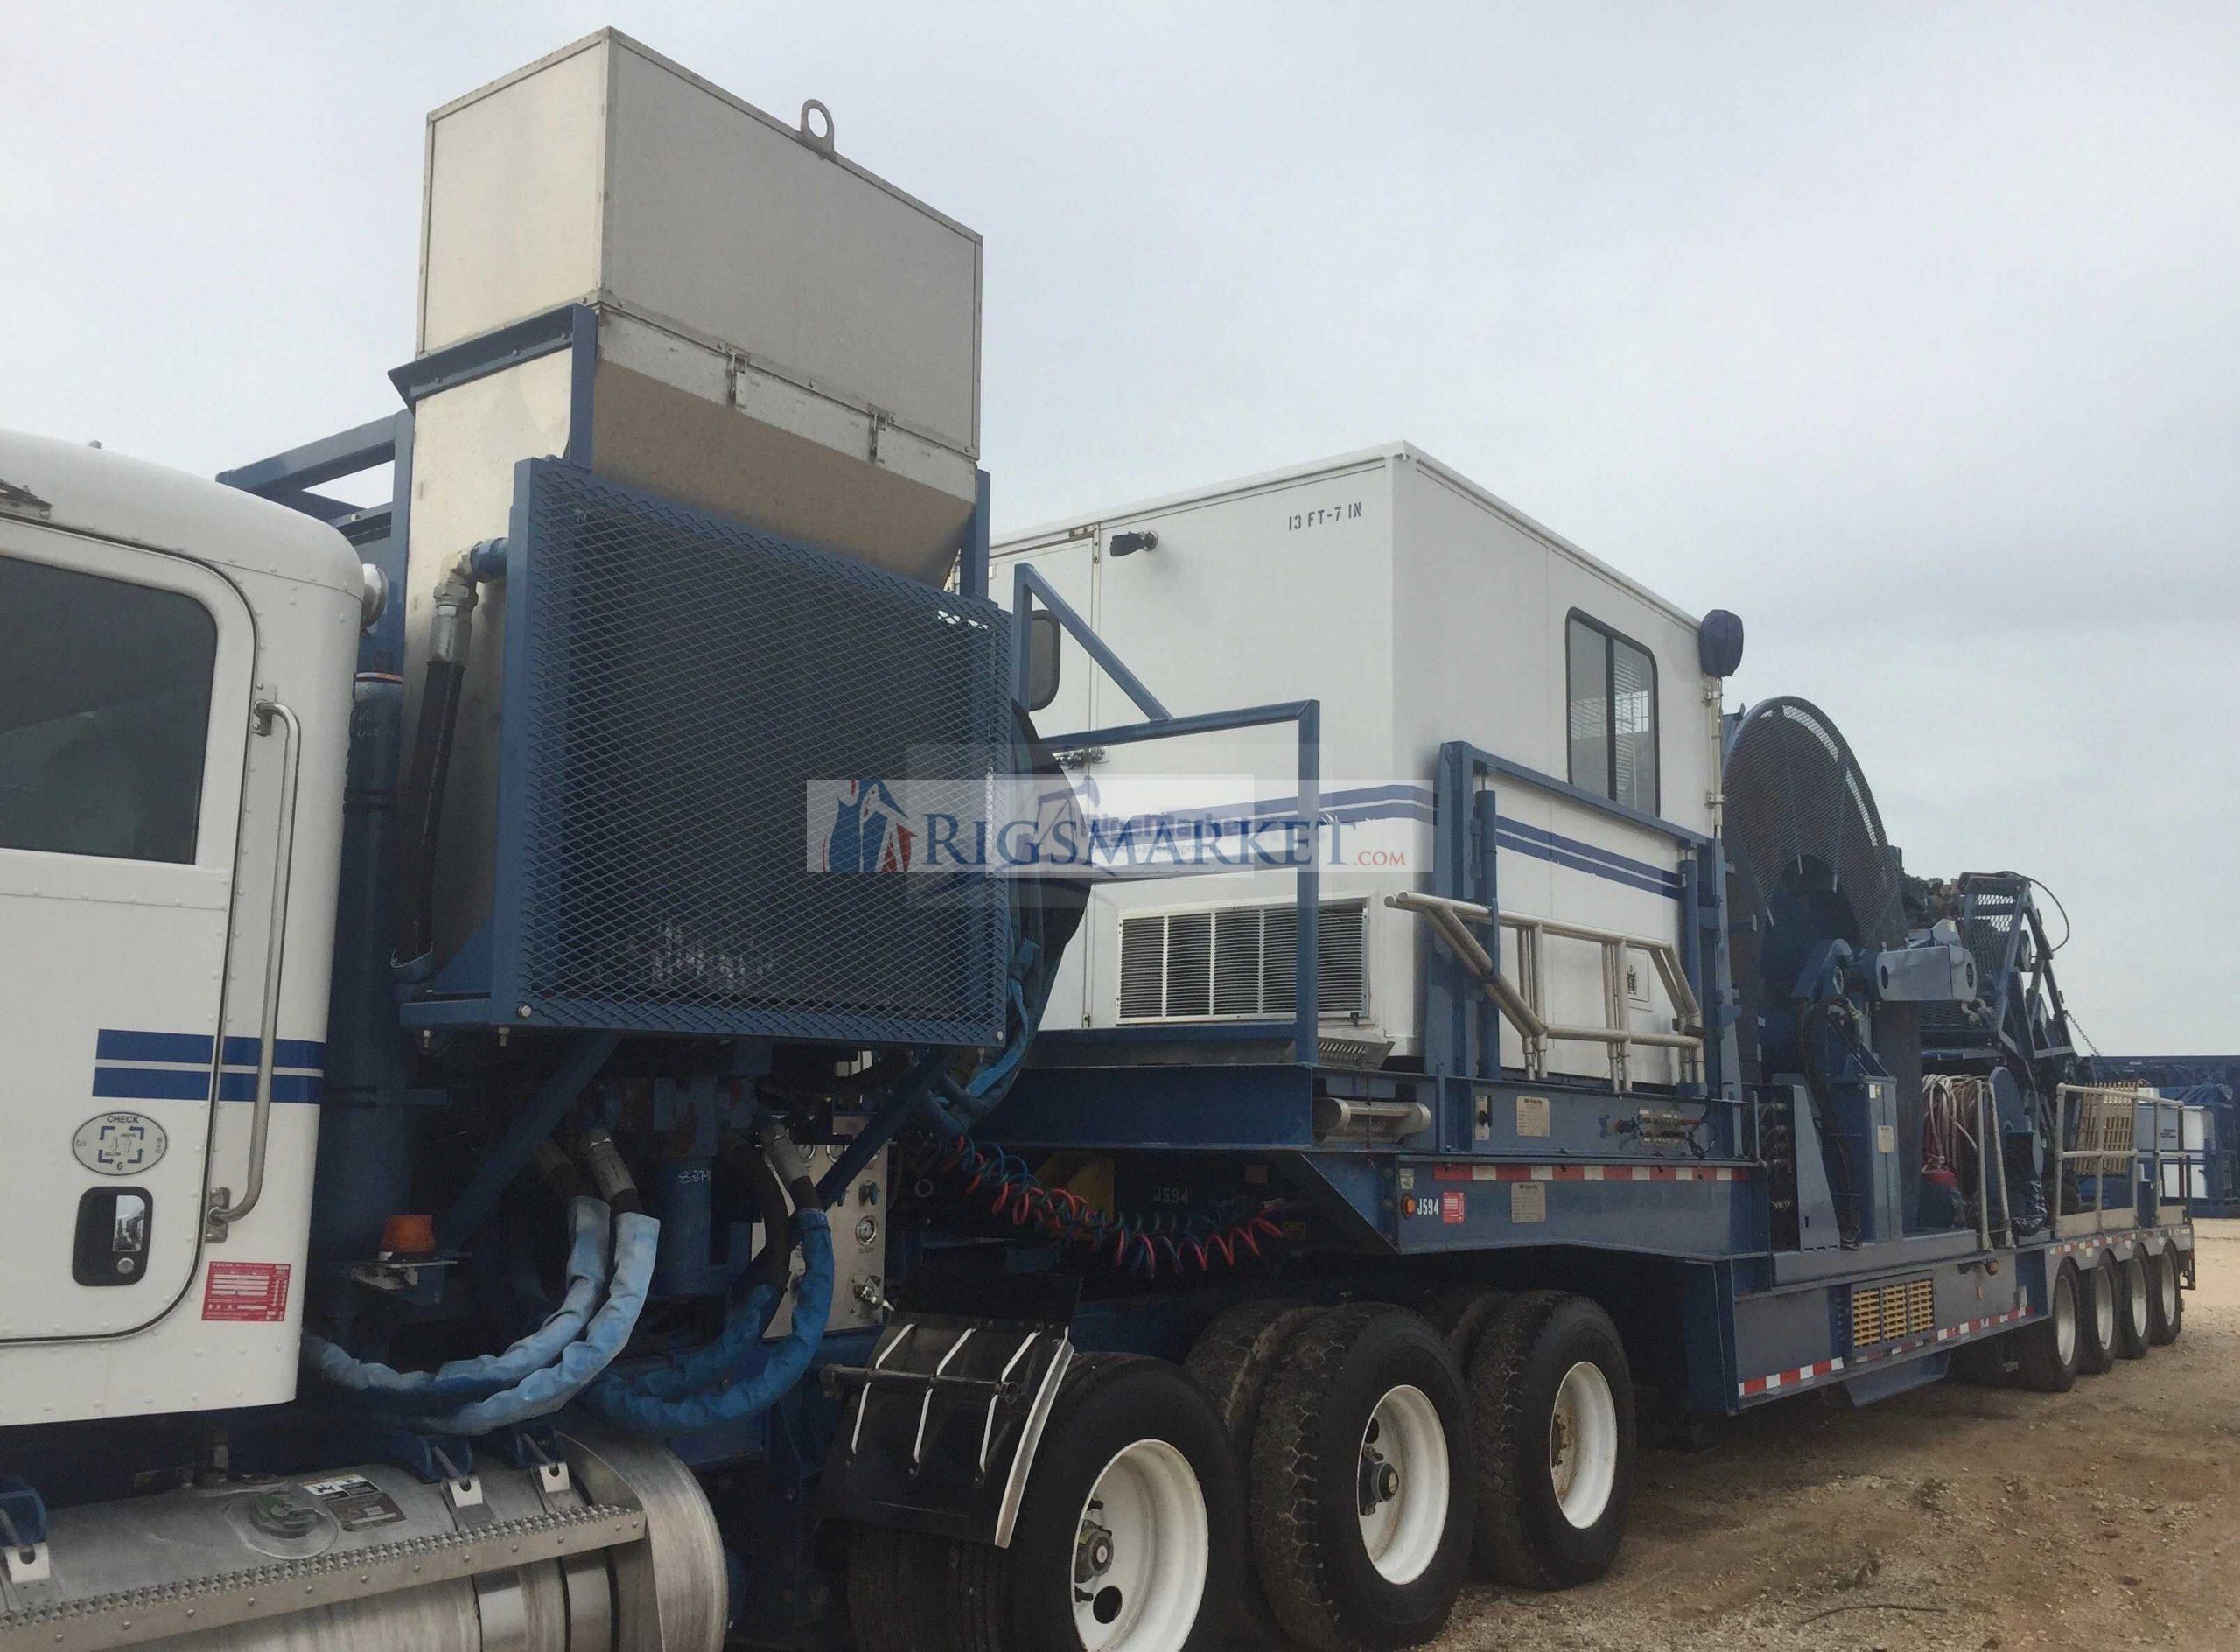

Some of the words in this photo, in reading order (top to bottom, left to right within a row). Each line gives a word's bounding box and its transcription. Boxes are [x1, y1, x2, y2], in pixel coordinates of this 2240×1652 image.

[1289, 514, 1302, 531] 13
[1307, 506, 1341, 527] FT-7
[1348, 502, 1362, 519] IN
[107, 1115, 139, 1124] CHECK
[116, 1161, 123, 1171] 6
[1418, 1198, 1439, 1215] J594
